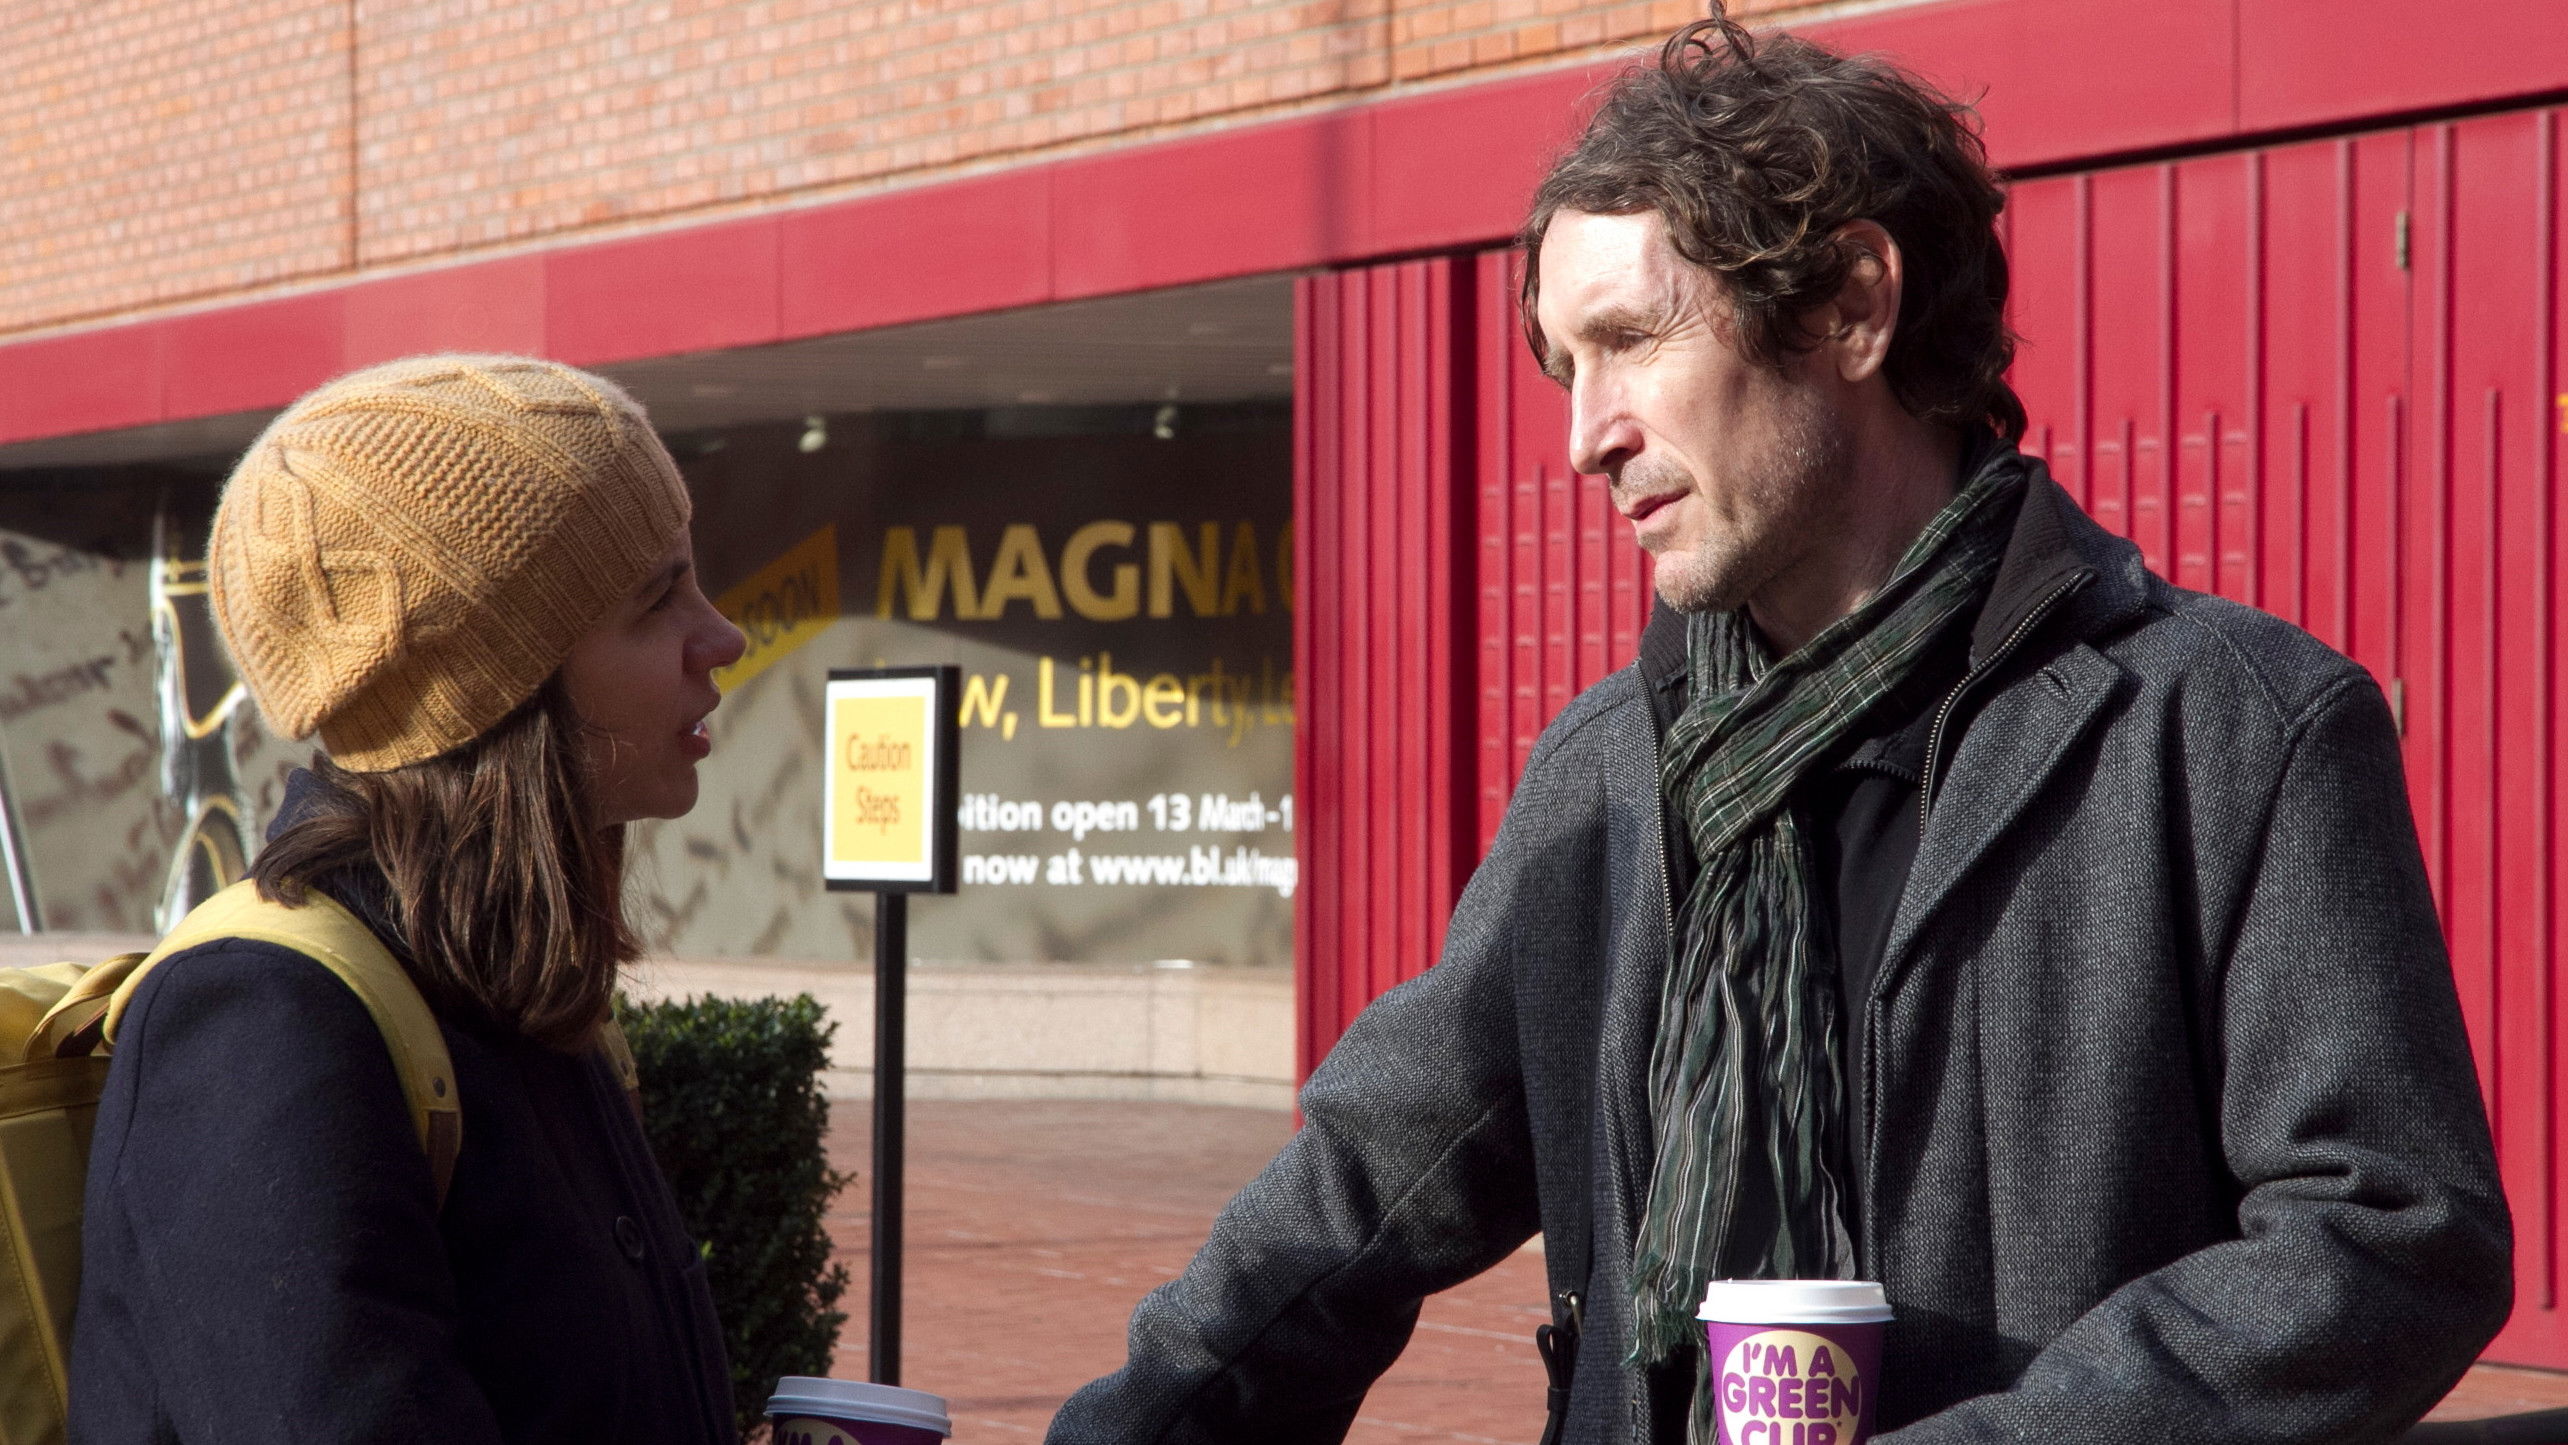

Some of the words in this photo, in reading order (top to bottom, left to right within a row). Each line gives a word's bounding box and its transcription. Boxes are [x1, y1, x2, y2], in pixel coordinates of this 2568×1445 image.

[876, 520, 1265, 621] MAGNA
[845, 732, 912, 772] Caution
[855, 785, 901, 836] Steps
[958, 792, 1043, 832] ition
[1051, 801, 1138, 841] open
[1146, 792, 1192, 832] 13
[962, 854, 1040, 885] now
[1046, 847, 1084, 885] at
[1743, 1342, 1798, 1377] I'M
[1808, 1345, 1836, 1377] A
[1723, 1372, 1860, 1419] GREEN
